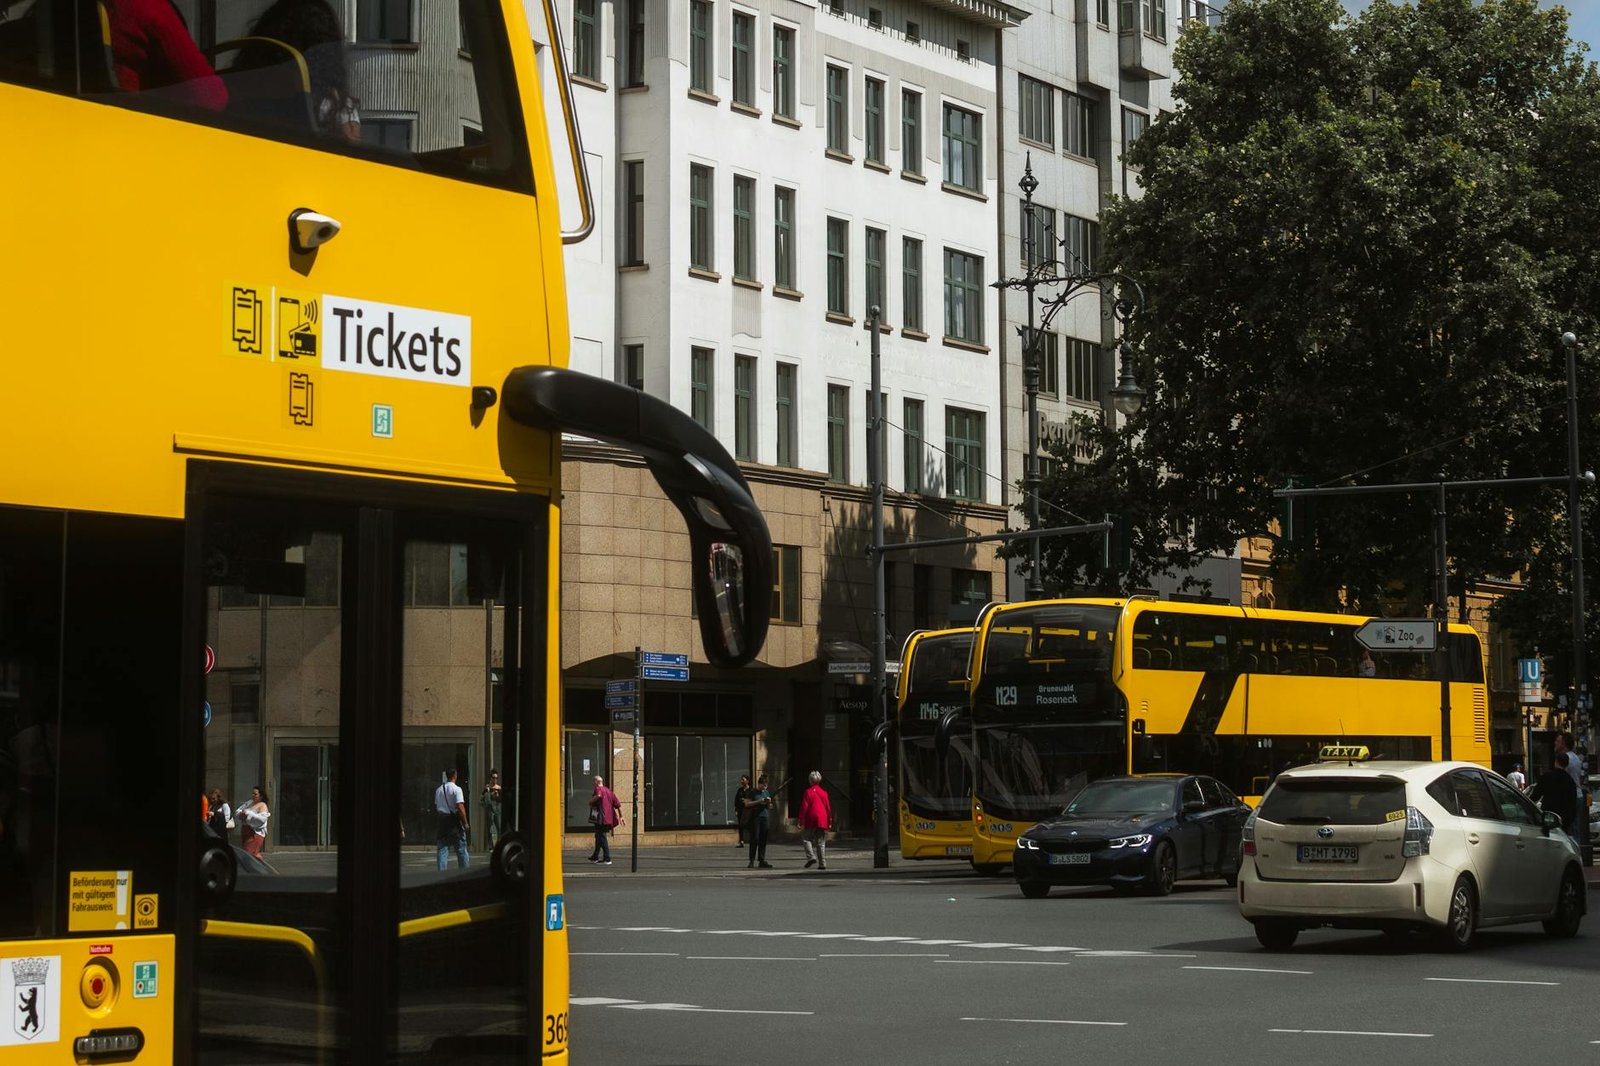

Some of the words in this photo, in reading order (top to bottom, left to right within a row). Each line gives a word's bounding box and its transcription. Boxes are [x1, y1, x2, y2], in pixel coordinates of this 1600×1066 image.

[332, 306, 463, 379] Tickets
[1398, 629, 1415, 641] Zoo
[1527, 661, 1539, 680] U
[1038, 684, 1075, 693] Grunewald
[995, 686, 1018, 706] M29
[1036, 694, 1079, 705] Roseneck
[839, 699, 868, 711] Aesop
[919, 702, 940, 720] M46
[1326, 747, 1356, 757] TAXI
[1332, 847, 1357, 859] 1798
[73, 877, 115, 888] Beförderung
[116, 878, 128, 886] nur
[72, 890, 84, 899] mit
[85, 889, 116, 901] gültigem
[72, 902, 113, 912] Fahrausweis
[138, 918, 155, 926] Video
